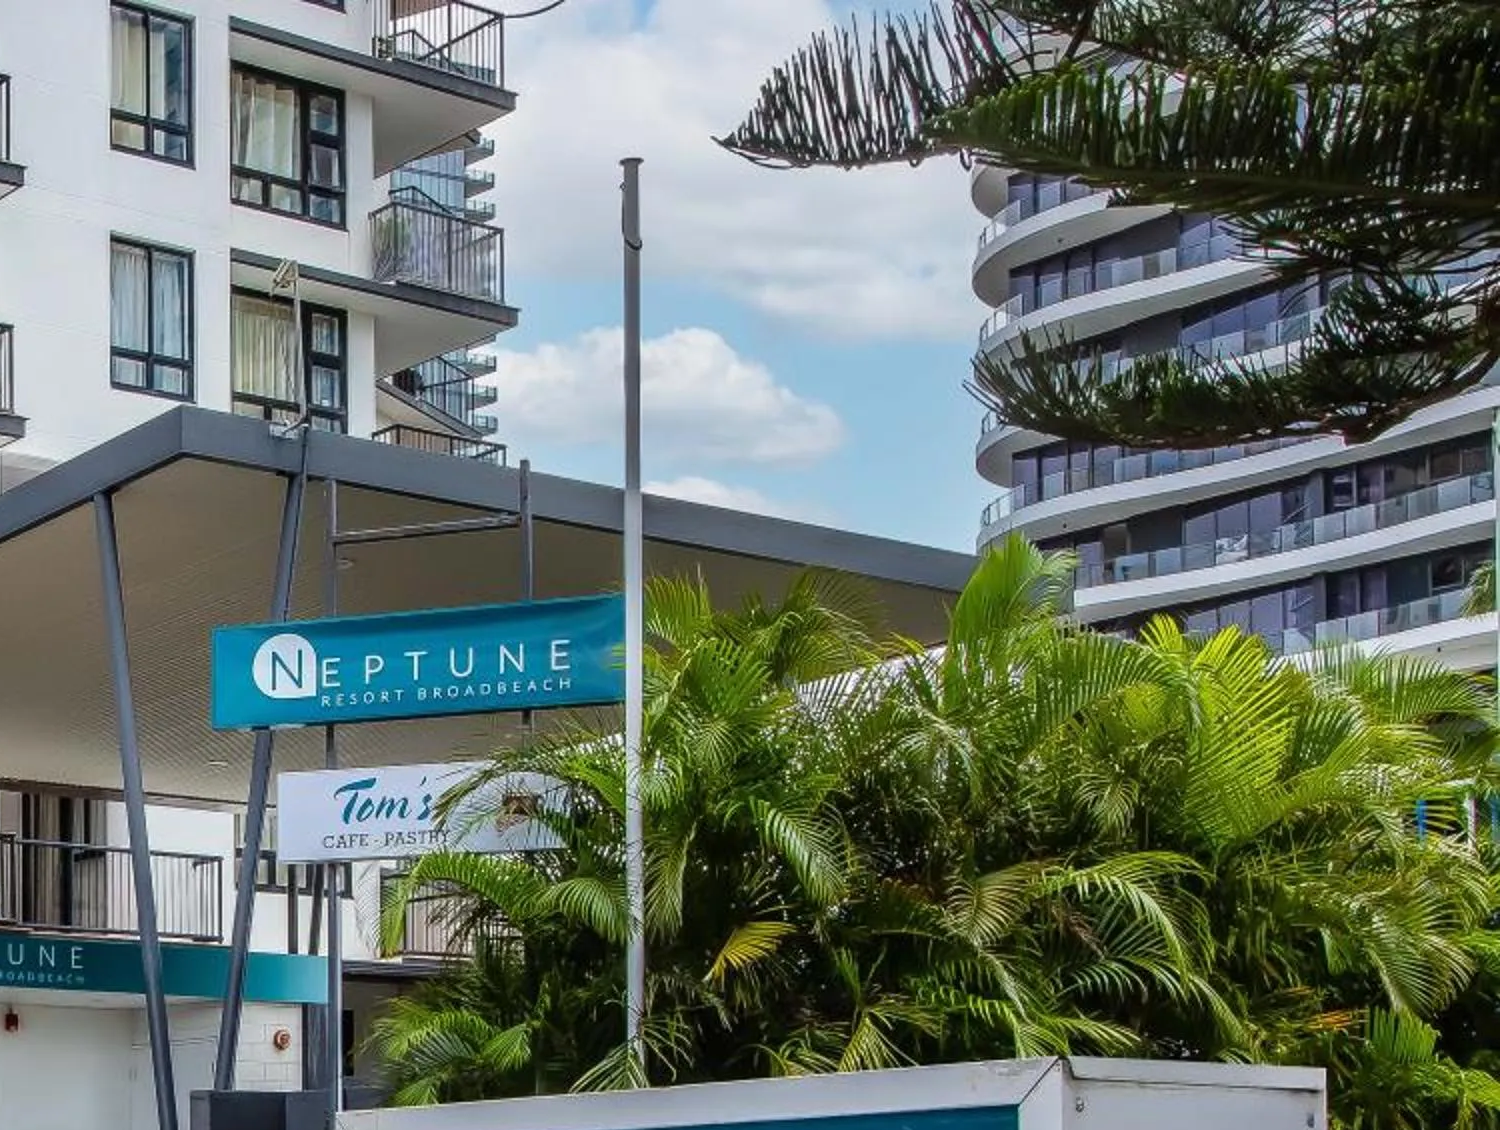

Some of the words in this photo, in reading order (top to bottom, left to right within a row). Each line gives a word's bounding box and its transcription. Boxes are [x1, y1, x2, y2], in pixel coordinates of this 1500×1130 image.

[270, 639, 571, 691] NEPTUNE
[321, 689, 404, 707] RESORT
[418, 678, 571, 700] BROADBEACH
[333, 776, 433, 825] Tom's
[323, 832, 369, 850] CAFE
